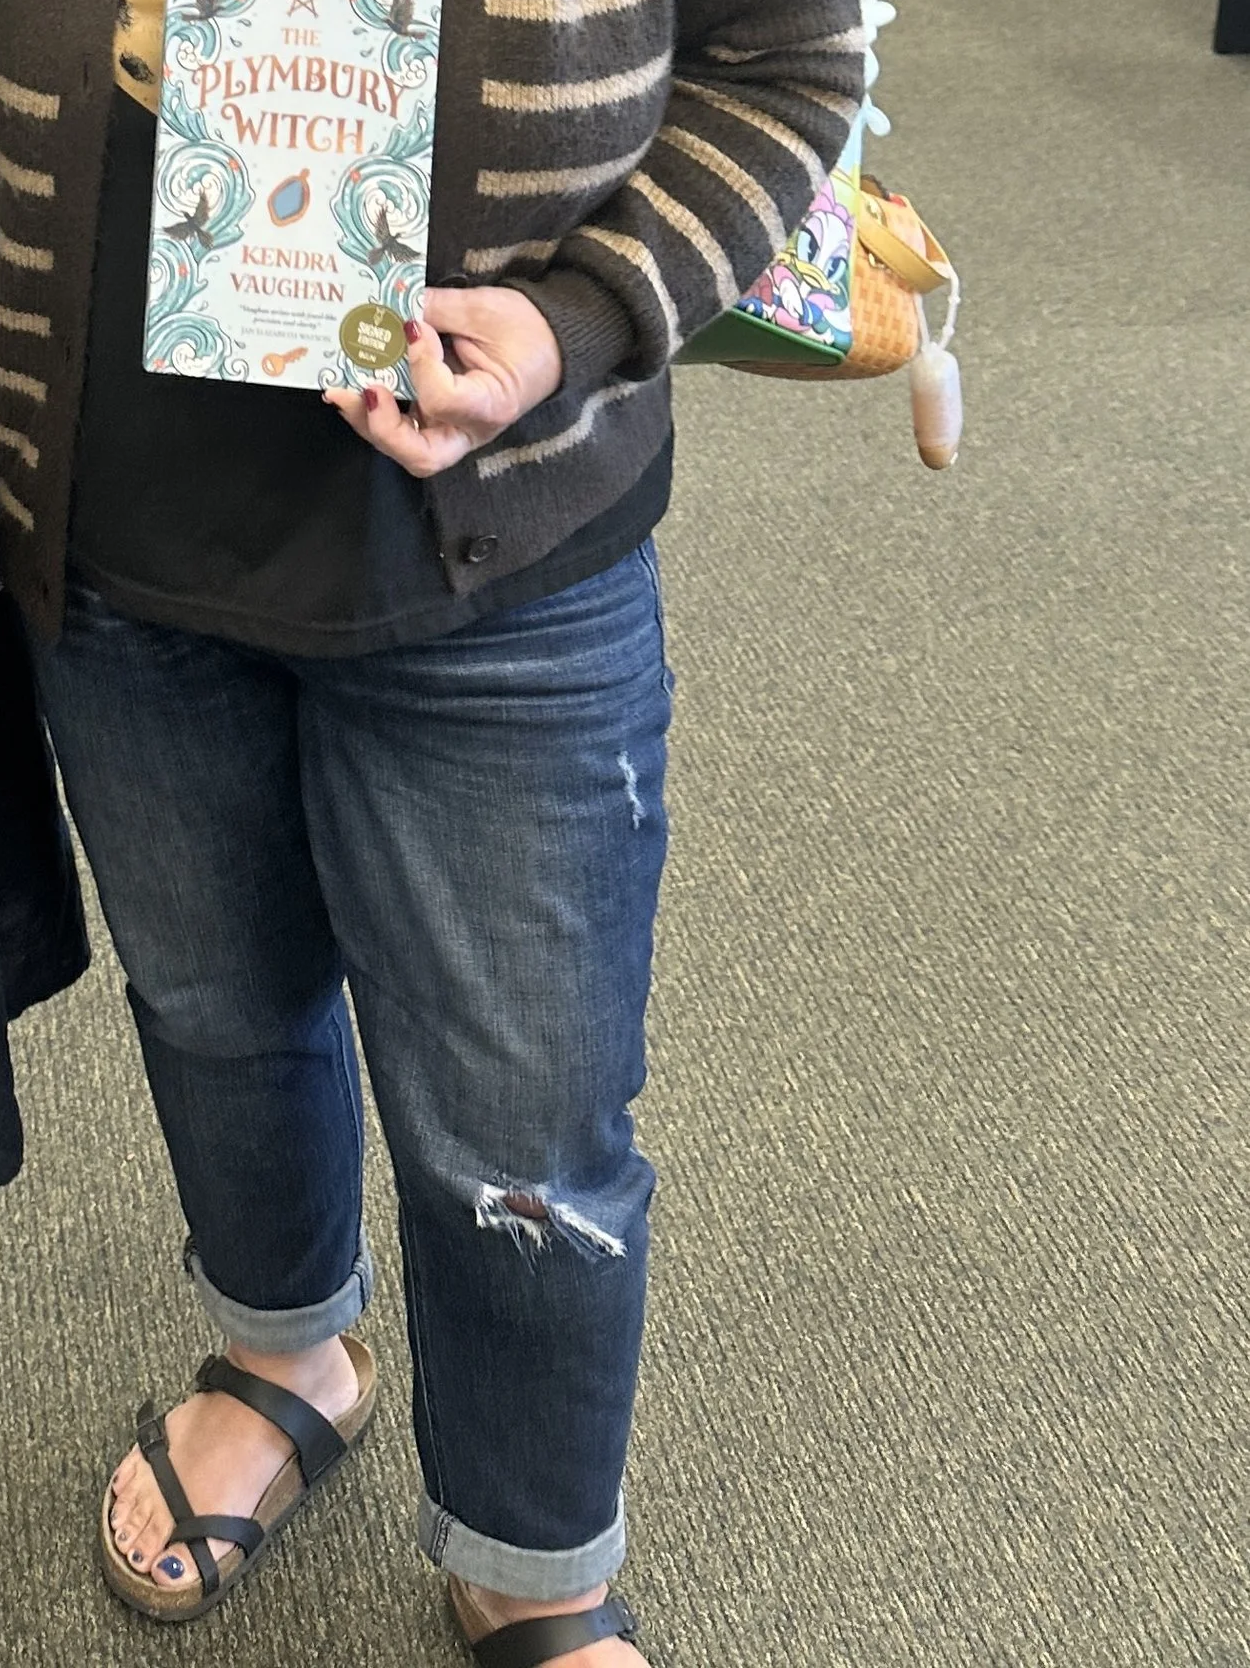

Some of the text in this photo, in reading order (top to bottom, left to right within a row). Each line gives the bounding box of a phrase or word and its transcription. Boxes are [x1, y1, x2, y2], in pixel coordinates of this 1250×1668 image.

[281, 27, 321, 48] THE
[191, 55, 406, 121] PLYMBURY
[220, 103, 365, 155] WITCH
[241, 245, 339, 274] KENDRA
[230, 273, 345, 303] VAUGHAN
[358, 321, 392, 343] SIGNED
